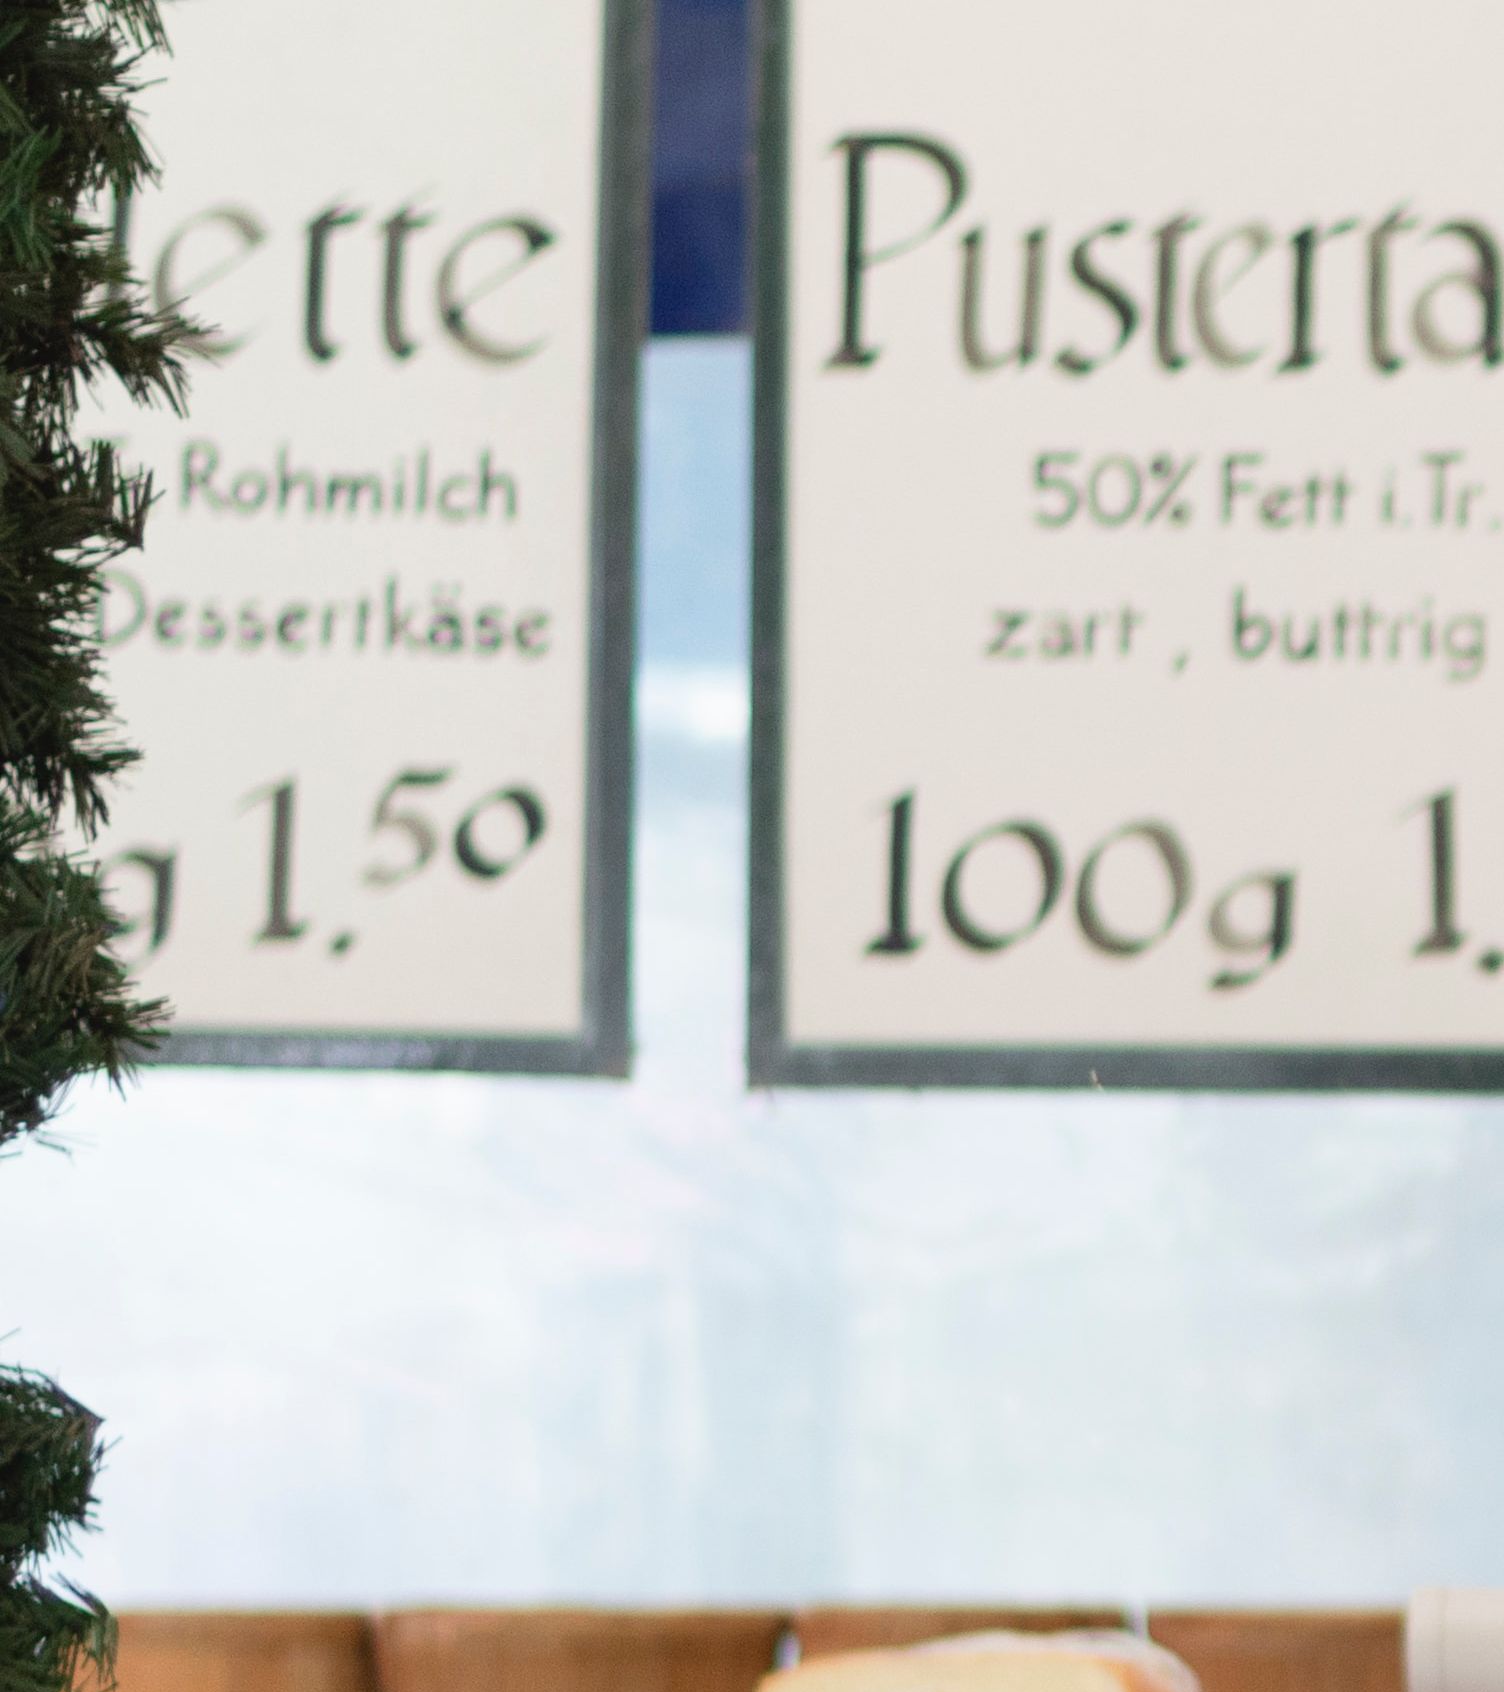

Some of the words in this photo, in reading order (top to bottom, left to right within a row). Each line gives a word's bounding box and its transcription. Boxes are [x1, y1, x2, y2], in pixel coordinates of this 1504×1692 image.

[180, 438, 518, 521] Rohmilch
[1030, 450, 1197, 530] 50%
[1217, 450, 1354, 530] Fett
[1228, 583, 1488, 684] buttrig
[233, 766, 550, 960] 1.50
[862, 788, 1300, 990] 100g
